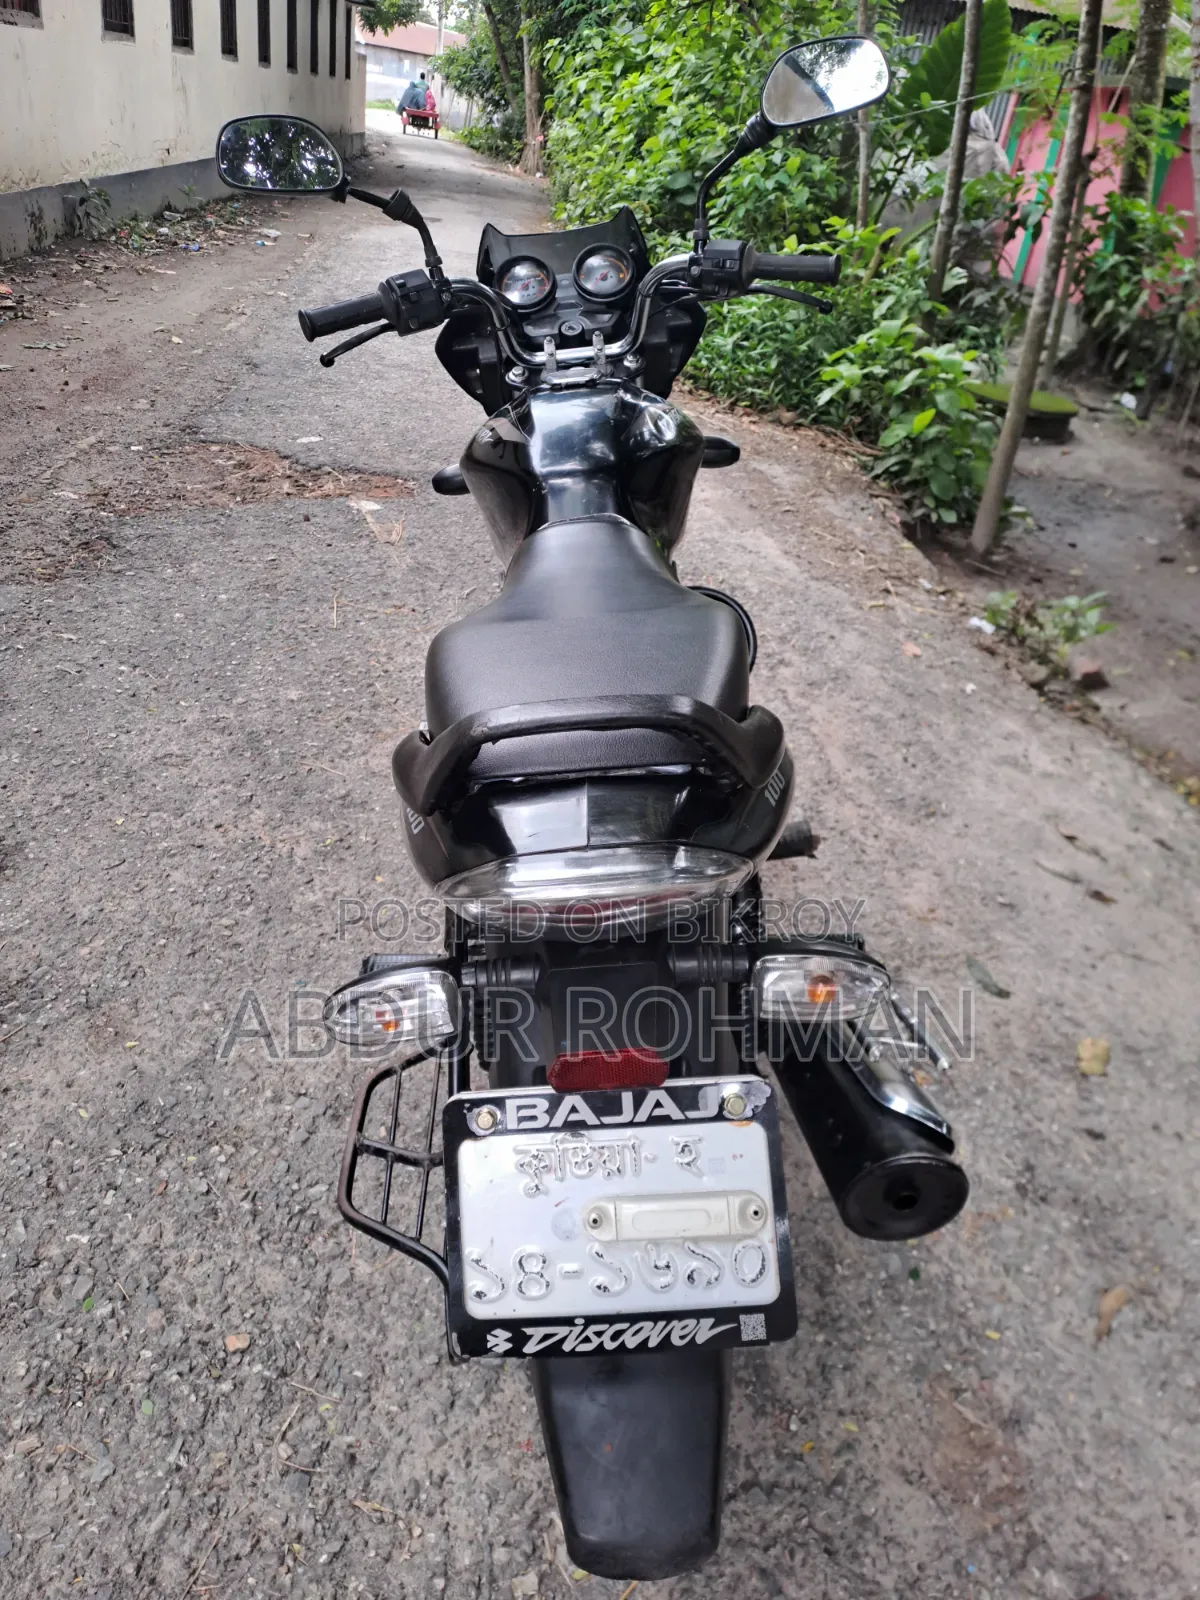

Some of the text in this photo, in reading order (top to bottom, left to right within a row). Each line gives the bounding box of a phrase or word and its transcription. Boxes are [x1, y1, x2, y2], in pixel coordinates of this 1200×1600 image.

[764, 769, 786, 808] 100
[505, 1086, 720, 1129] BAJAJ
[520, 1318, 739, 1353] Discover
